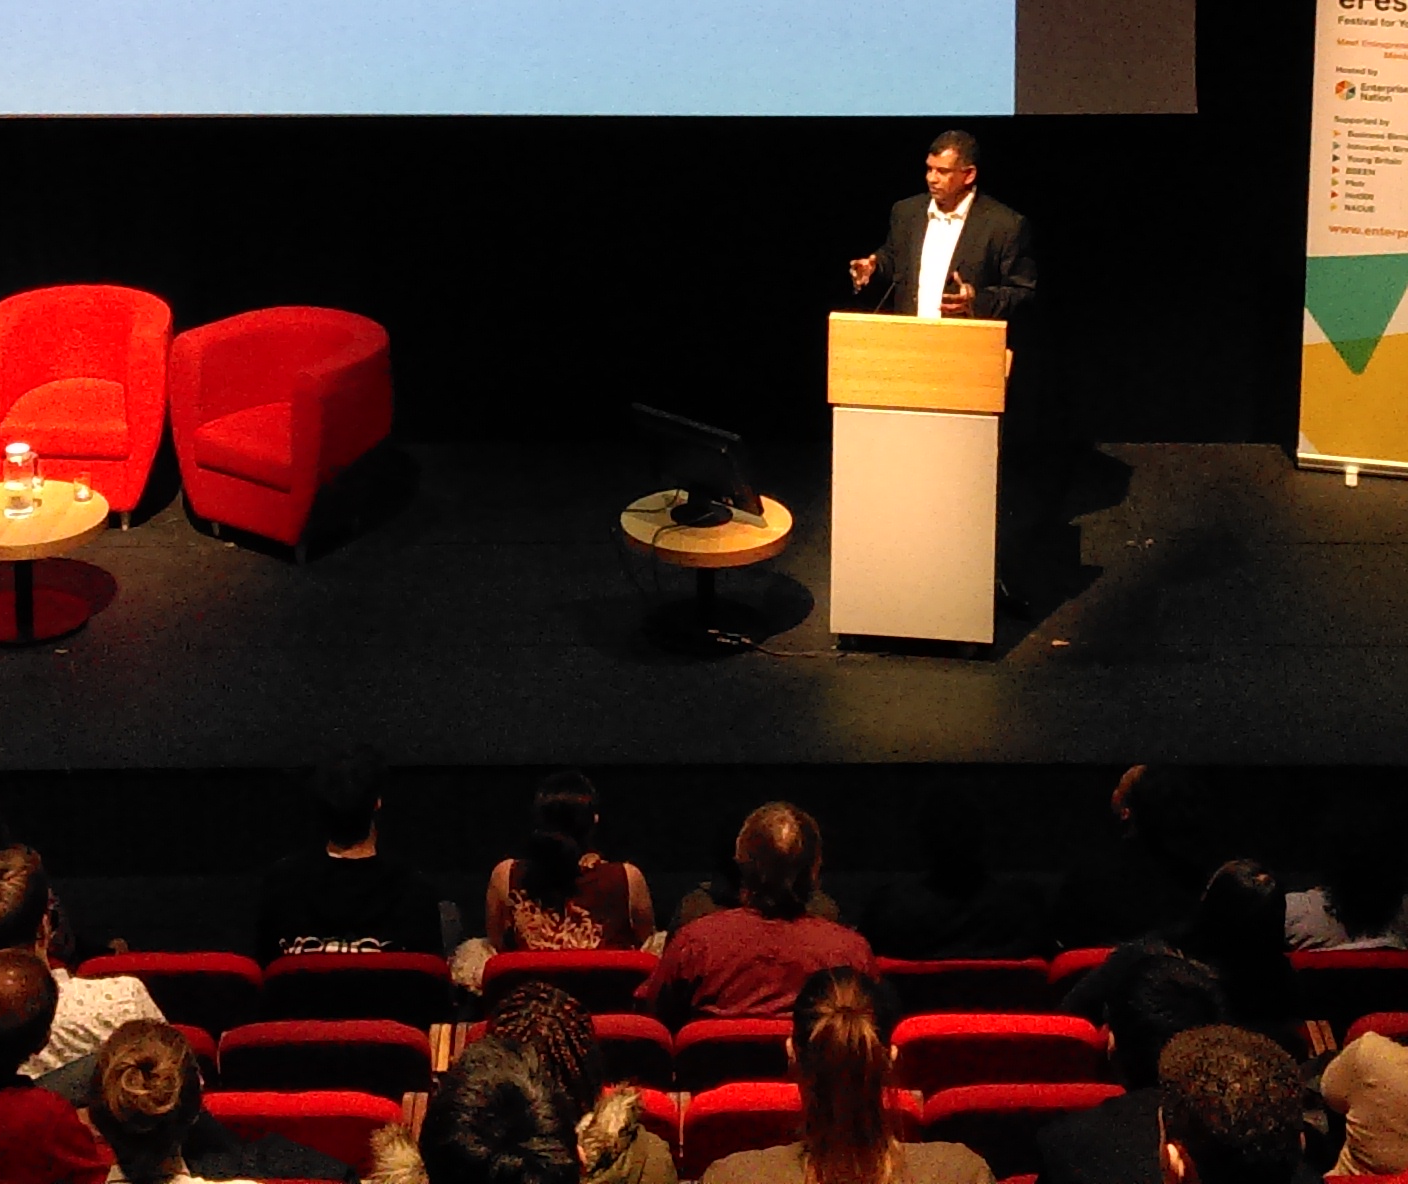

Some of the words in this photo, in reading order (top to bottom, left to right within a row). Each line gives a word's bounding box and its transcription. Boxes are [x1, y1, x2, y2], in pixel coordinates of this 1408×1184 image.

[1337, 16, 1378, 27] Festival
[1380, 18, 1396, 27] for
[1360, 93, 1392, 102] Nation
